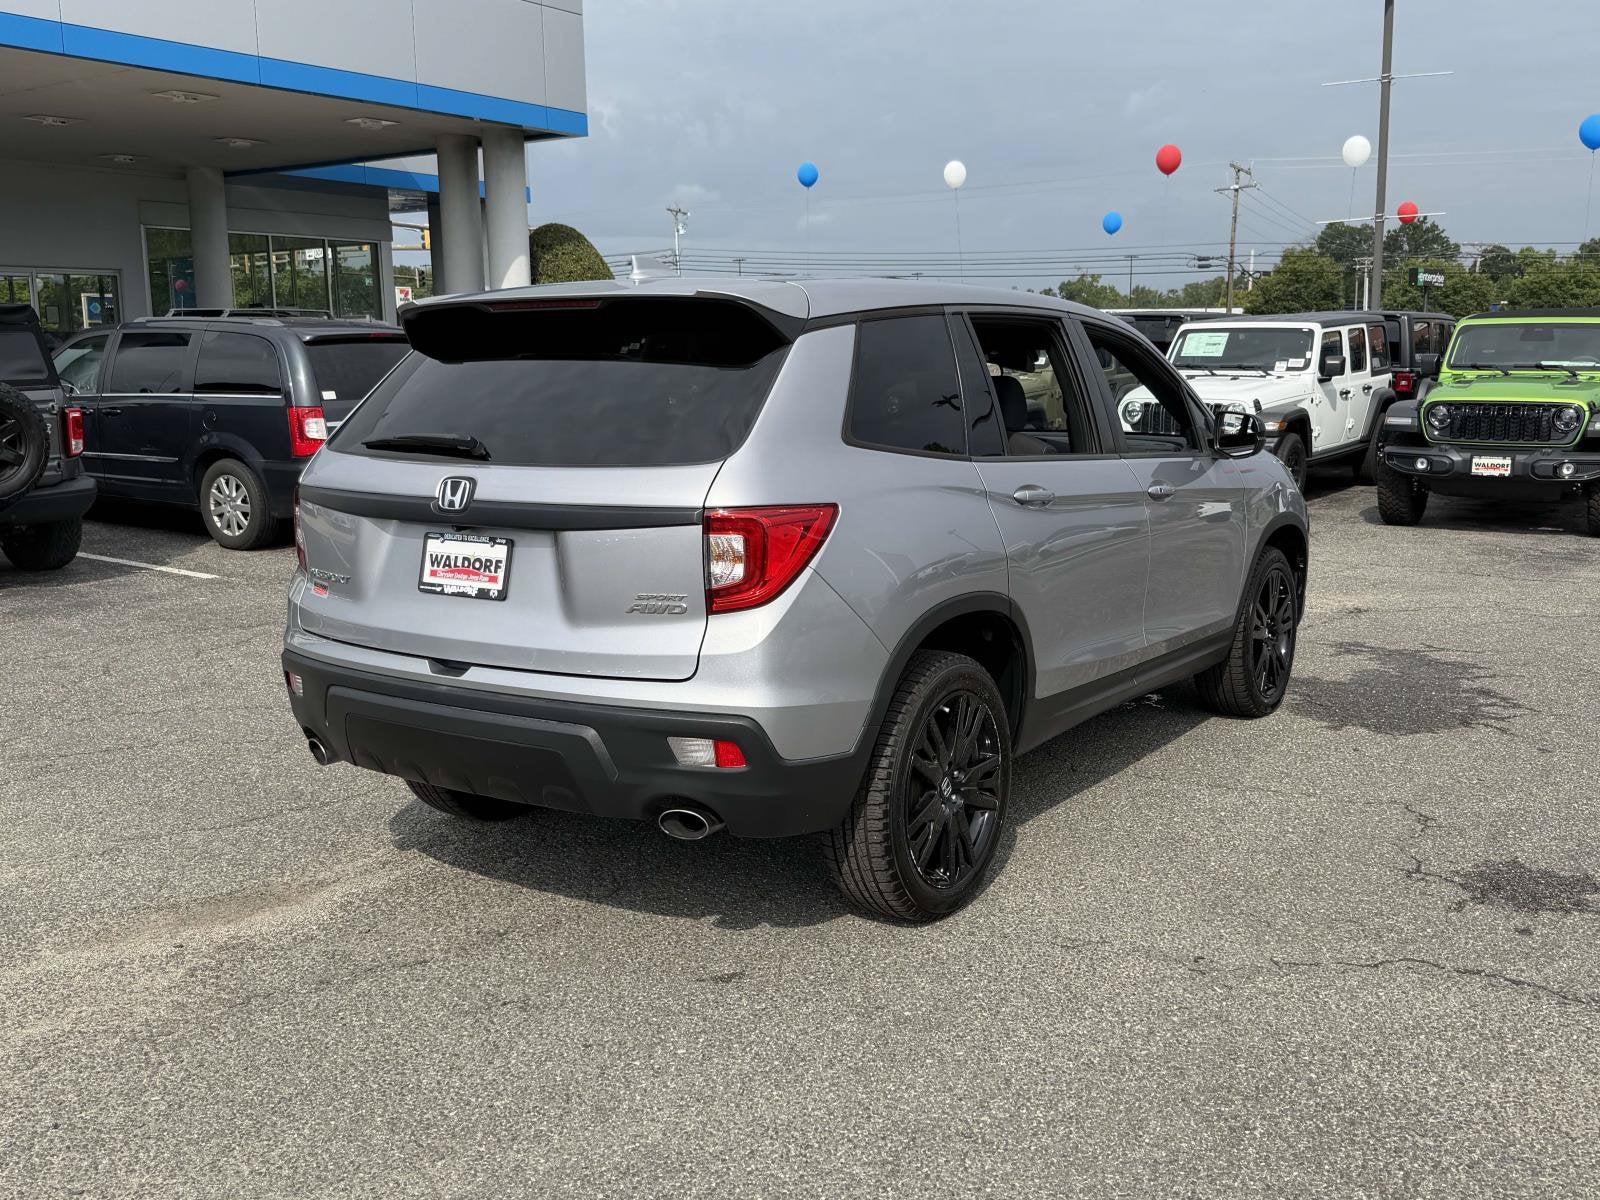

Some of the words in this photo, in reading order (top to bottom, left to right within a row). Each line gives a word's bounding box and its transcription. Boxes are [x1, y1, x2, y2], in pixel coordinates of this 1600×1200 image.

[1417, 272, 1445, 284] enterprise
[429, 553, 503, 574] WALDORF
[634, 593, 688, 602] SPORT
[625, 602, 688, 615] AWD
